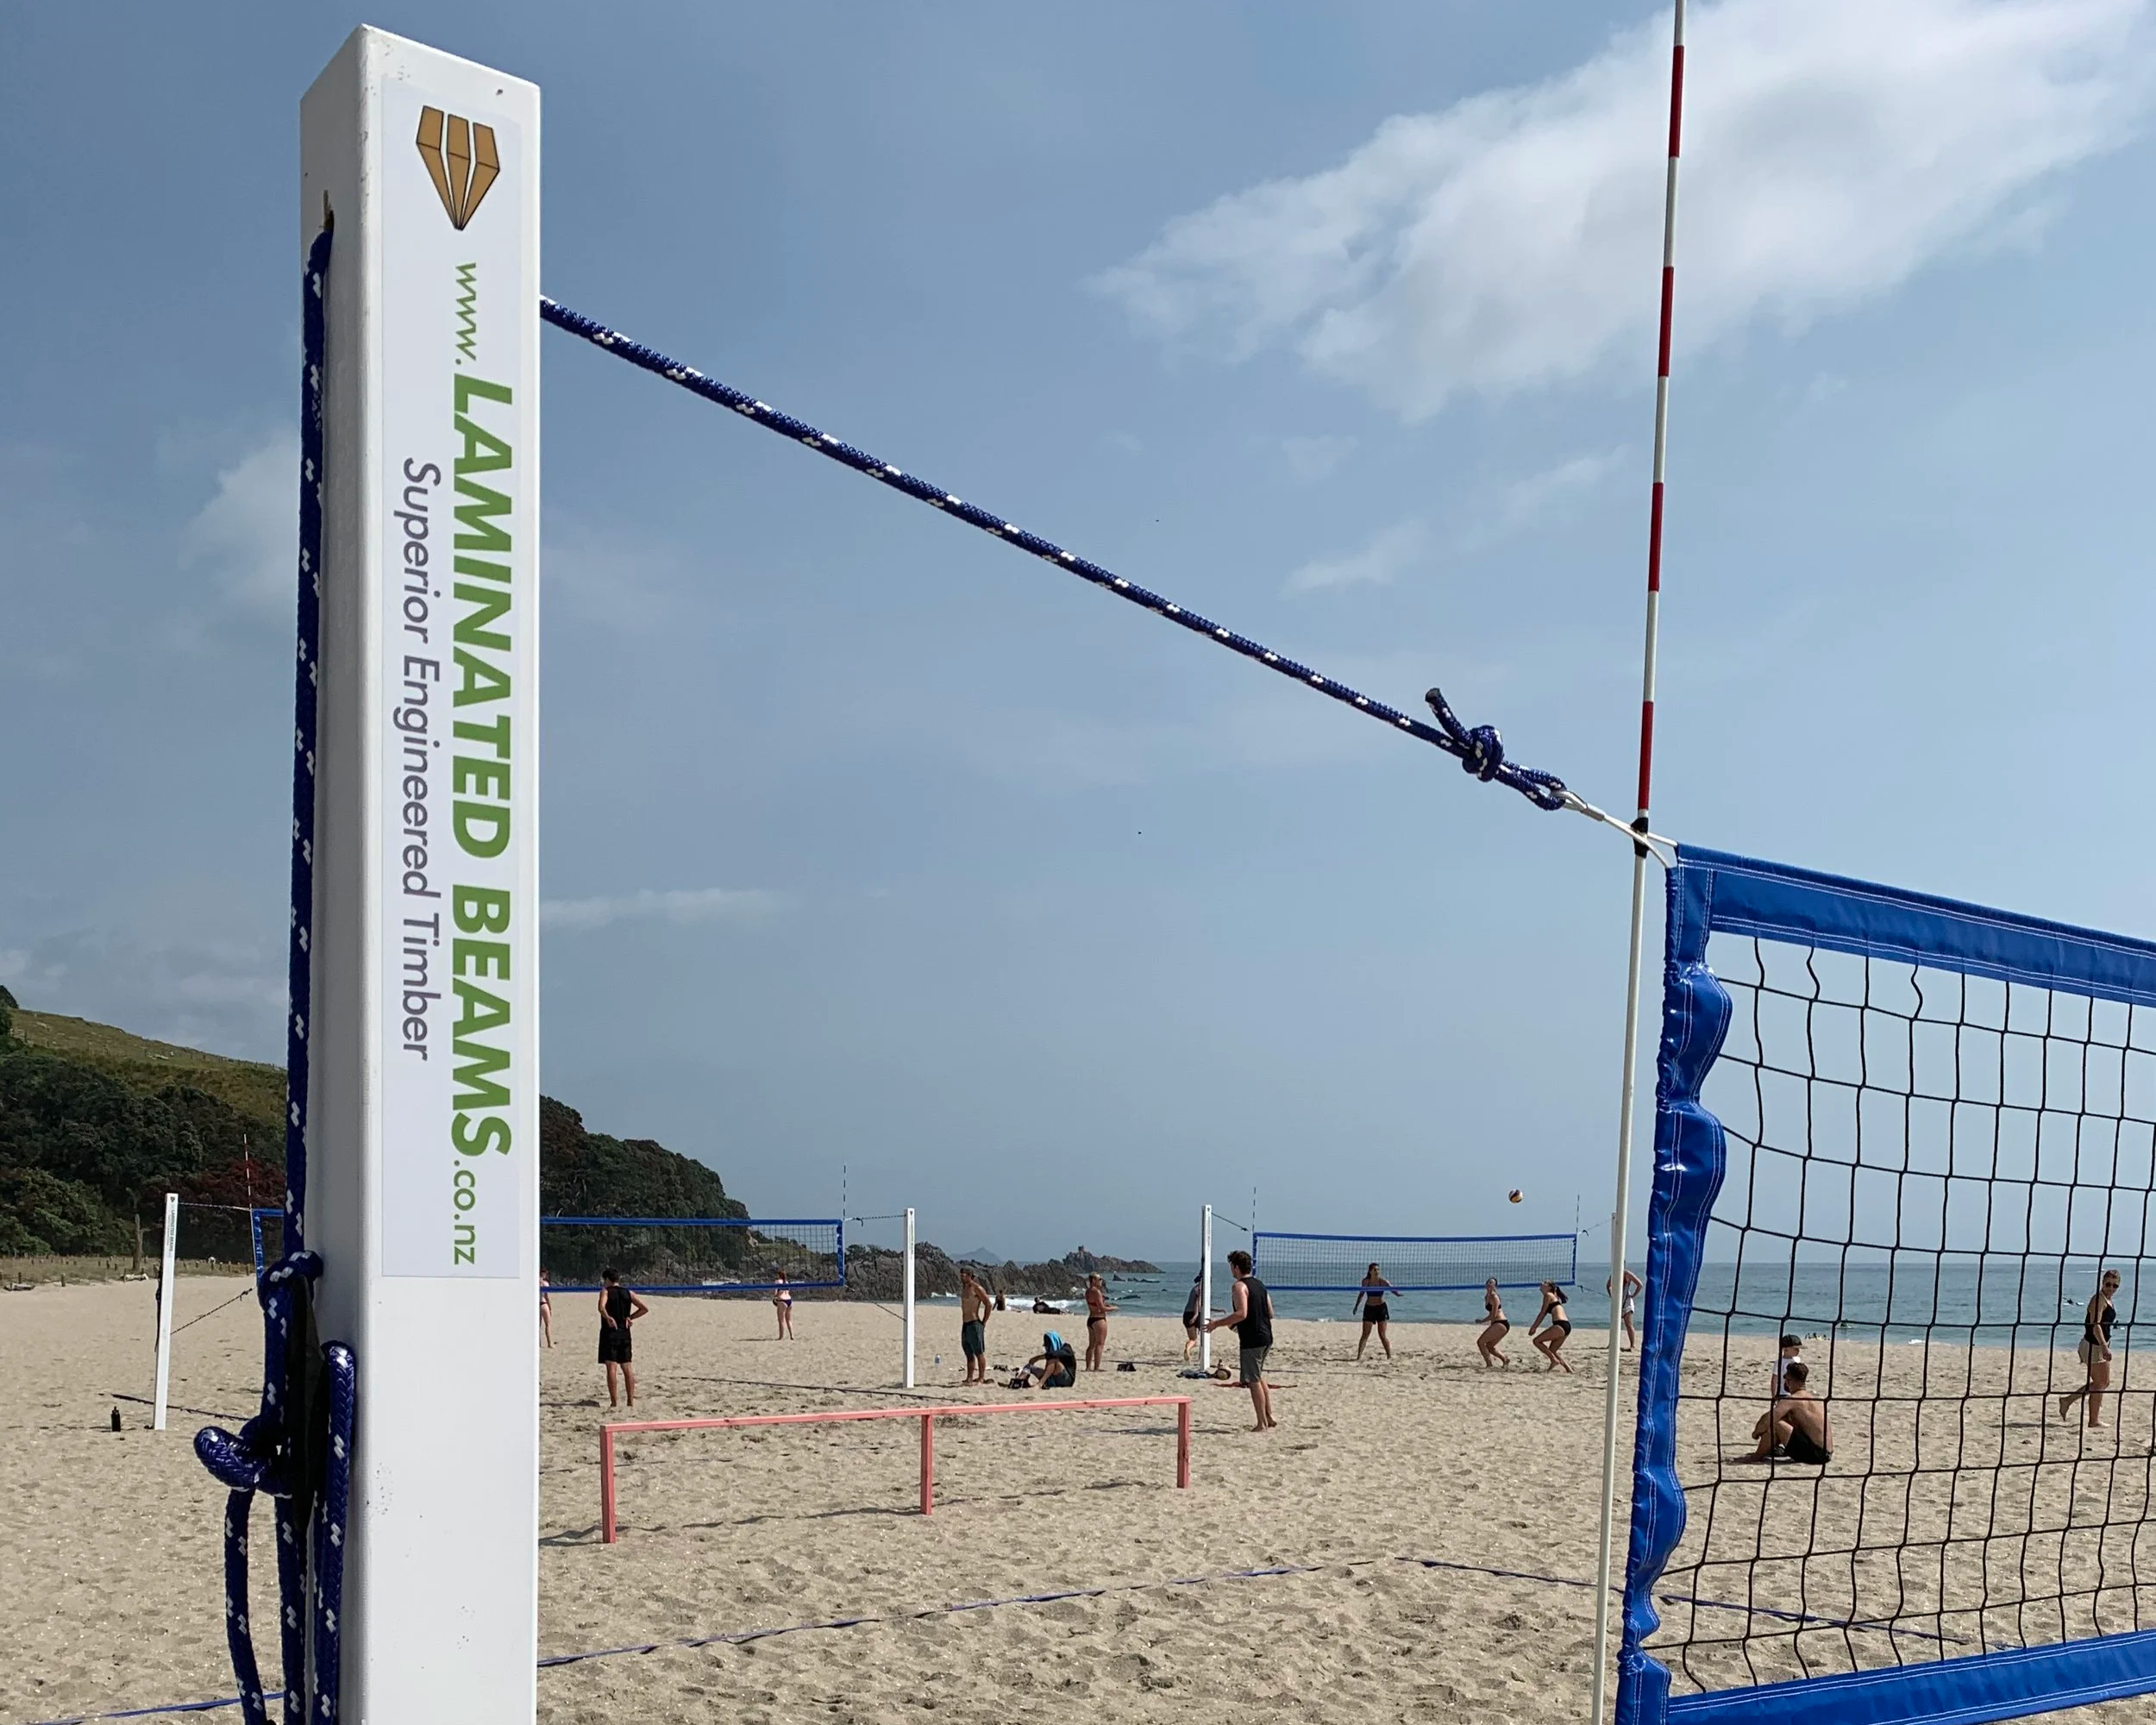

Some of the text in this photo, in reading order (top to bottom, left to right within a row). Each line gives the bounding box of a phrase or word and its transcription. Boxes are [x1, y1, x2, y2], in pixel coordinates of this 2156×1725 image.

[392, 457, 442, 1061] Superior Engineered Timber
